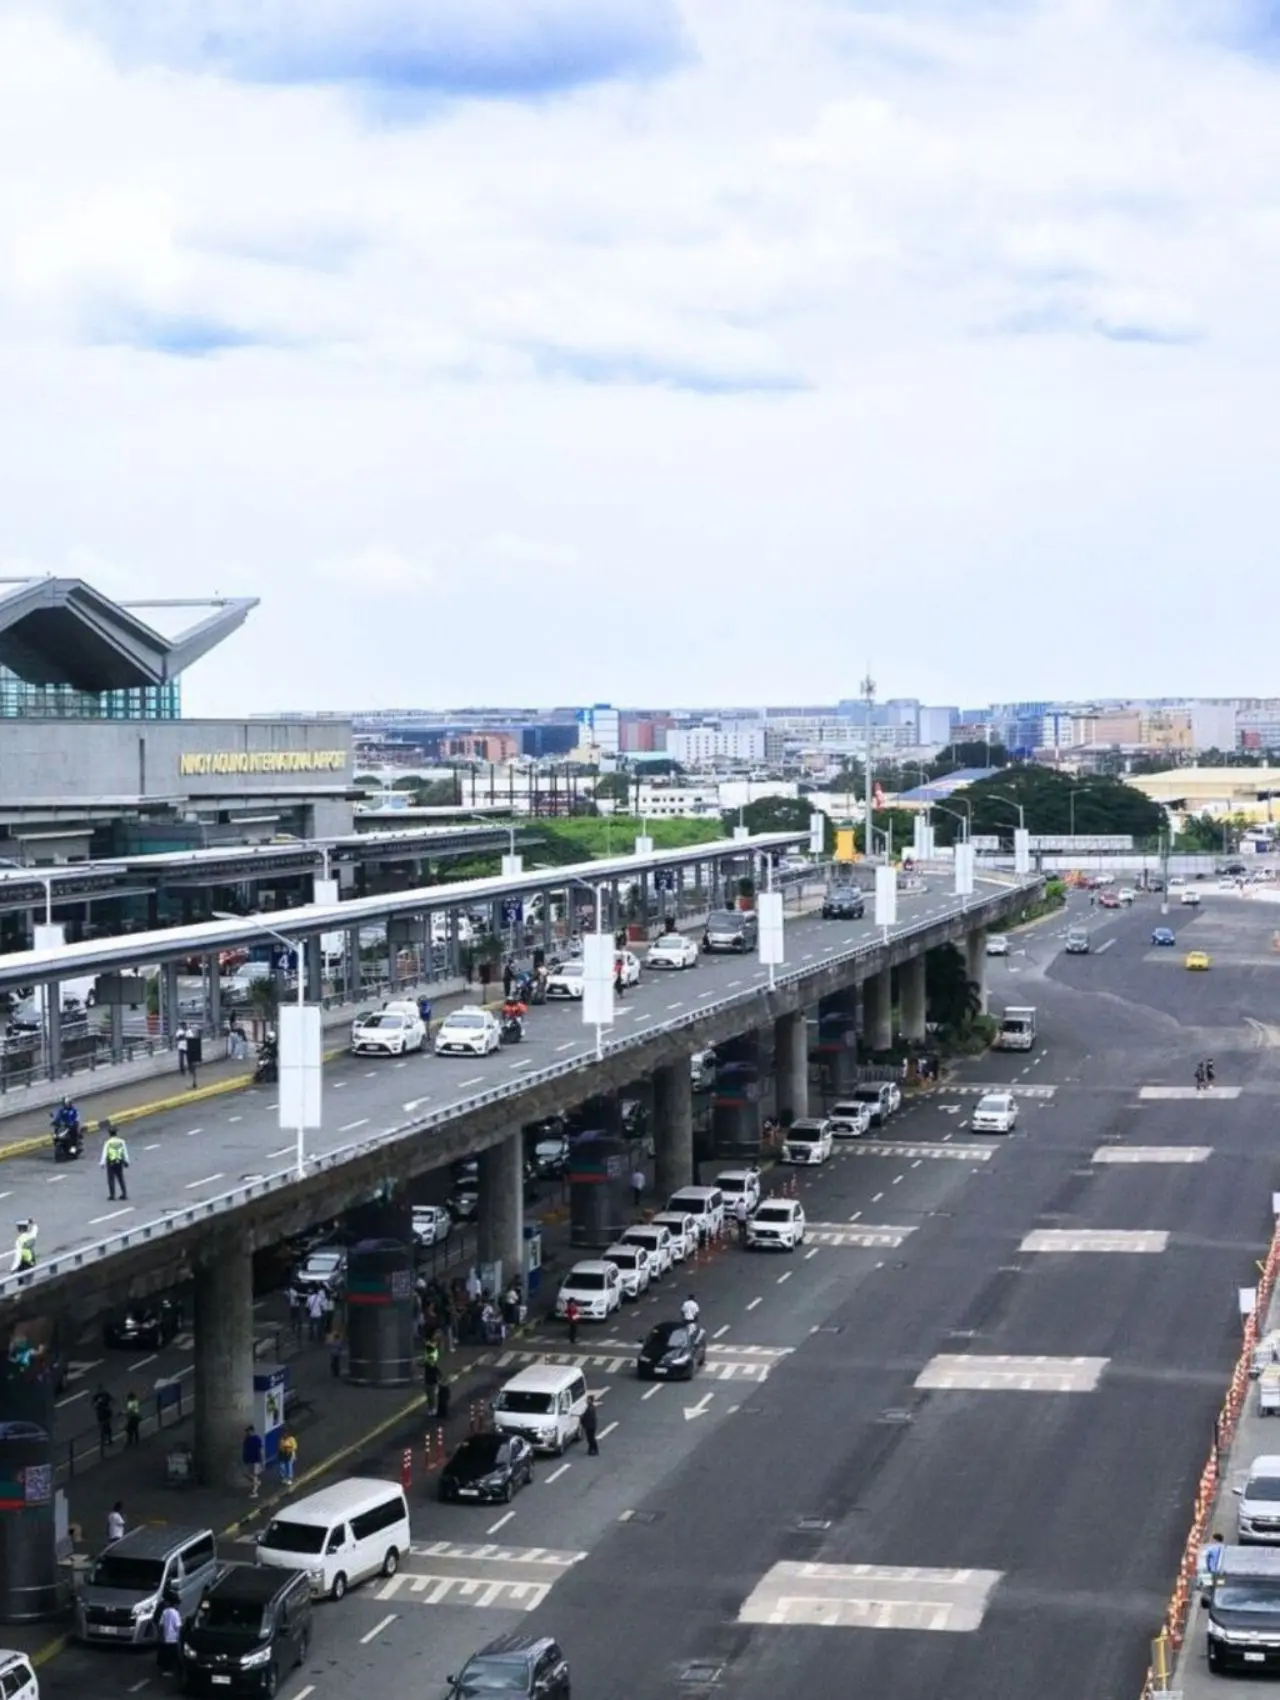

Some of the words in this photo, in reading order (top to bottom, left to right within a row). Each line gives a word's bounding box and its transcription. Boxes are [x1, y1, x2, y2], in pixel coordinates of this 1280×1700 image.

[212, 752, 248, 774] AQUINO
[249, 751, 313, 772] INTERNATIONAL
[313, 750, 346, 770] AIRPORT
[506, 909, 517, 921] 3
[277, 954, 290, 969] 4
